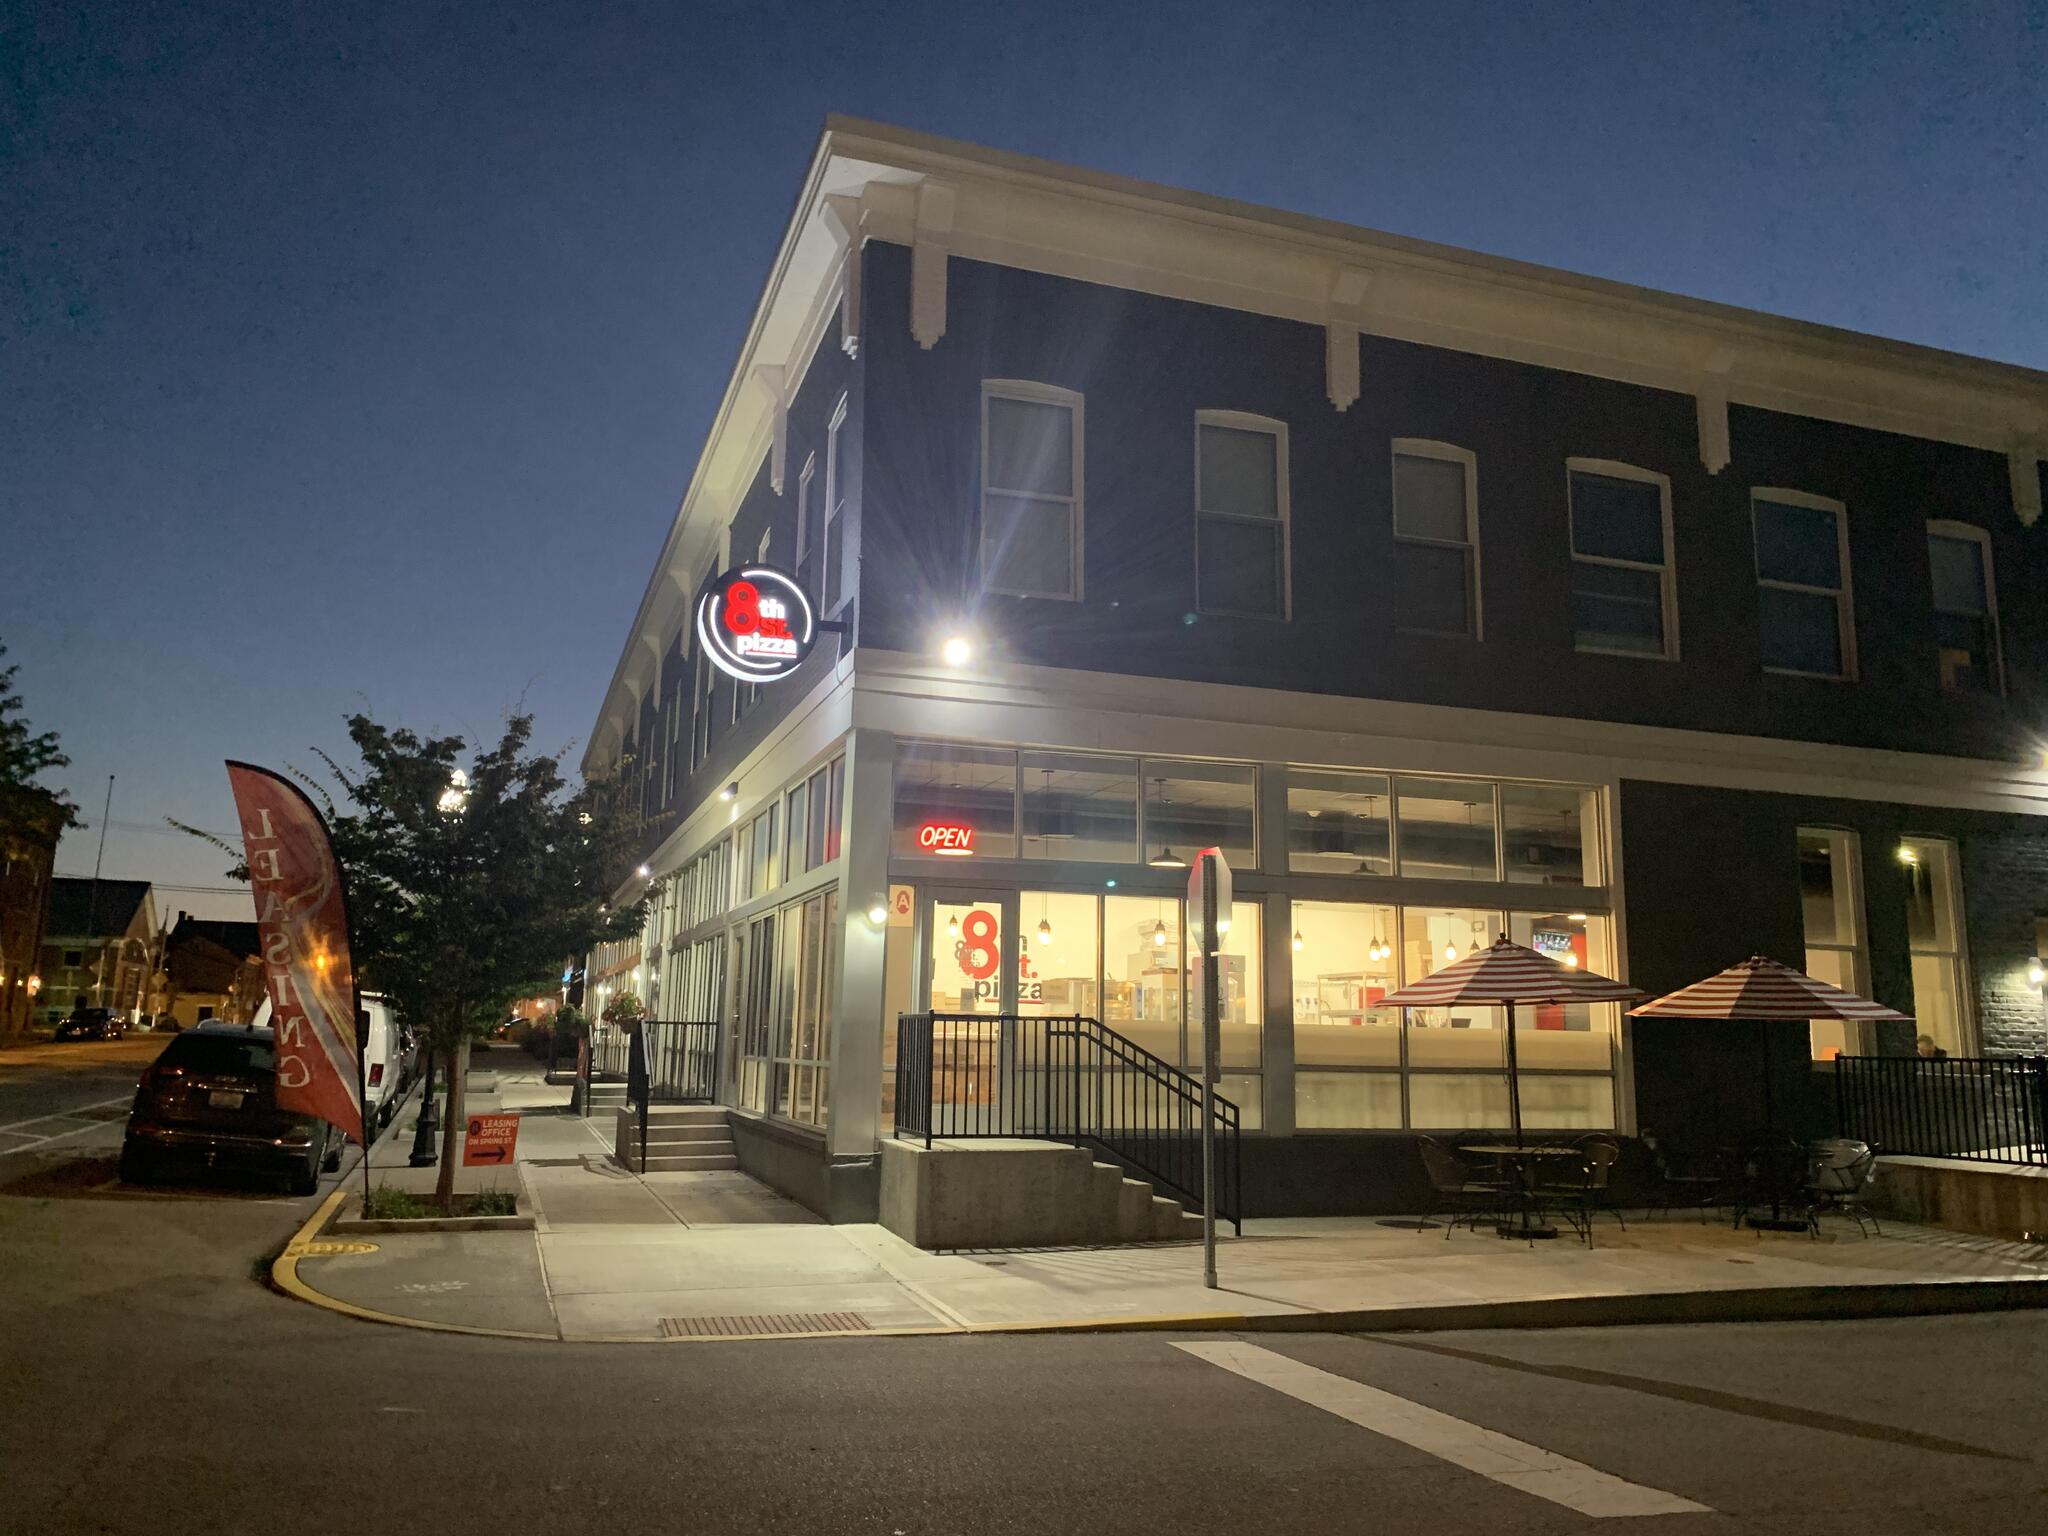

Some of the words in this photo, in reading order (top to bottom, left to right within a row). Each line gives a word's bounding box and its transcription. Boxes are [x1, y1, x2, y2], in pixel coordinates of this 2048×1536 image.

[737, 632, 797, 656] pizza
[920, 826, 971, 847] OPEN
[974, 975, 1042, 1003] piza
[481, 1128, 511, 1136] OFFICE
[483, 1119, 518, 1128] LEASING
